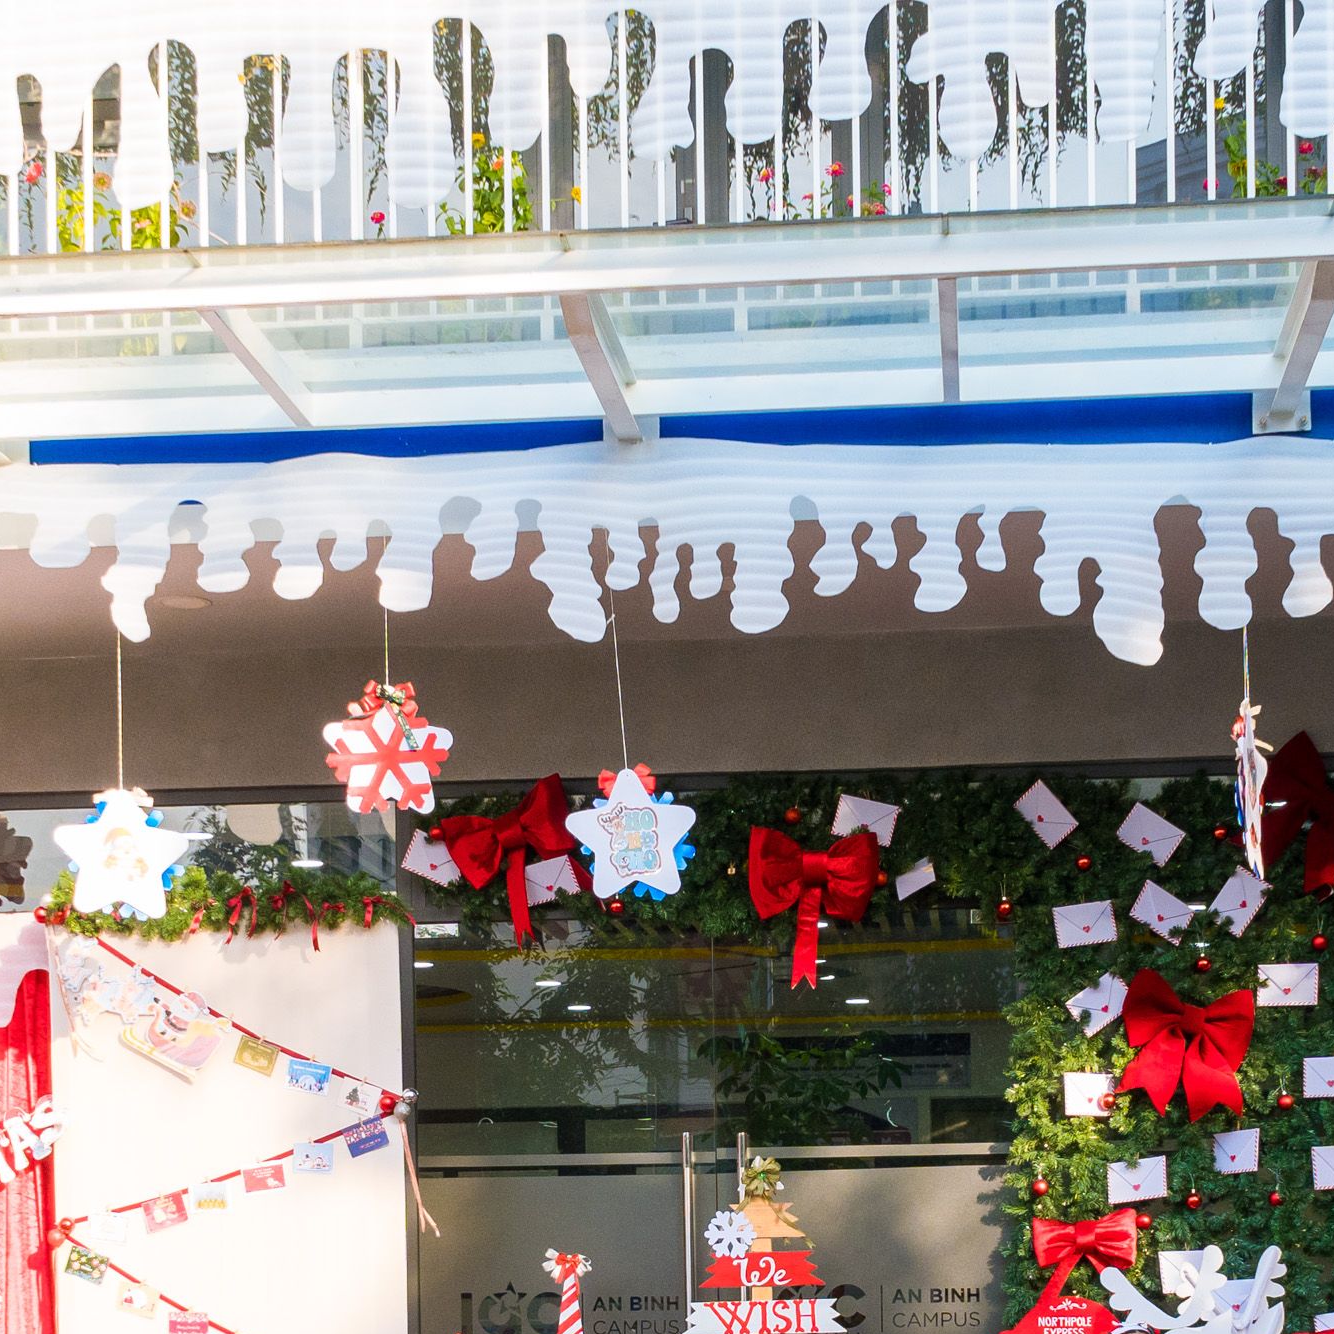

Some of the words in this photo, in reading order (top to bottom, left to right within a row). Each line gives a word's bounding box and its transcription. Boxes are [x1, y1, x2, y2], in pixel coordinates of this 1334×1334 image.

[733, 1257, 792, 1287] We
[593, 1296, 622, 1312] AN
[629, 1296, 680, 1311] BINH
[892, 1288, 922, 1304] AN
[929, 1287, 981, 1304] BINH
[892, 1311, 981, 1329] CAMPUS
[1037, 1316, 1092, 1328] NORTHPOLE
